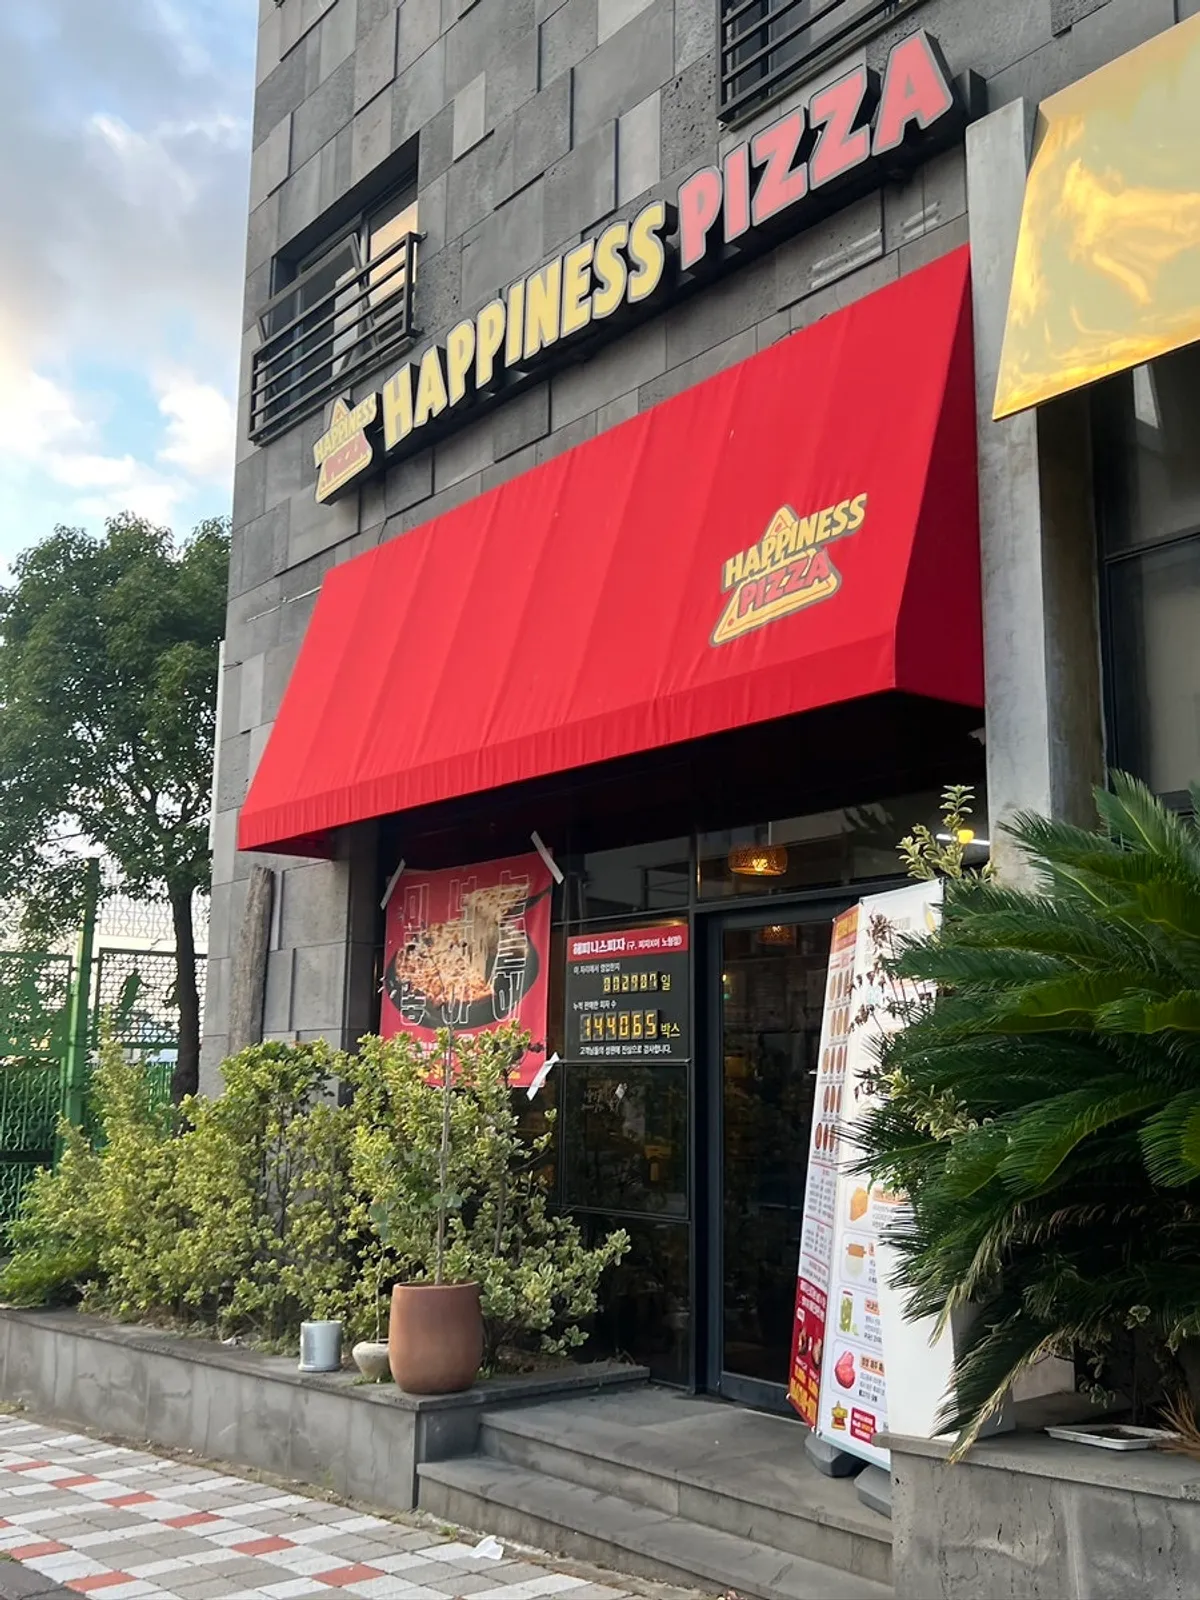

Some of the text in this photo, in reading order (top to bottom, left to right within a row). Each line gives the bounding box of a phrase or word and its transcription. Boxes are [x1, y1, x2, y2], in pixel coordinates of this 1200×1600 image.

[381, 29, 955, 454] HAPPINESS PIZZA
[724, 493, 868, 589] HAPPINESS
[737, 547, 831, 619] PIZZA
[573, 938, 625, 955] 해피니스피자
[661, 974, 671, 991] 일
[585, 1013, 680, 1038] 144065 박스
